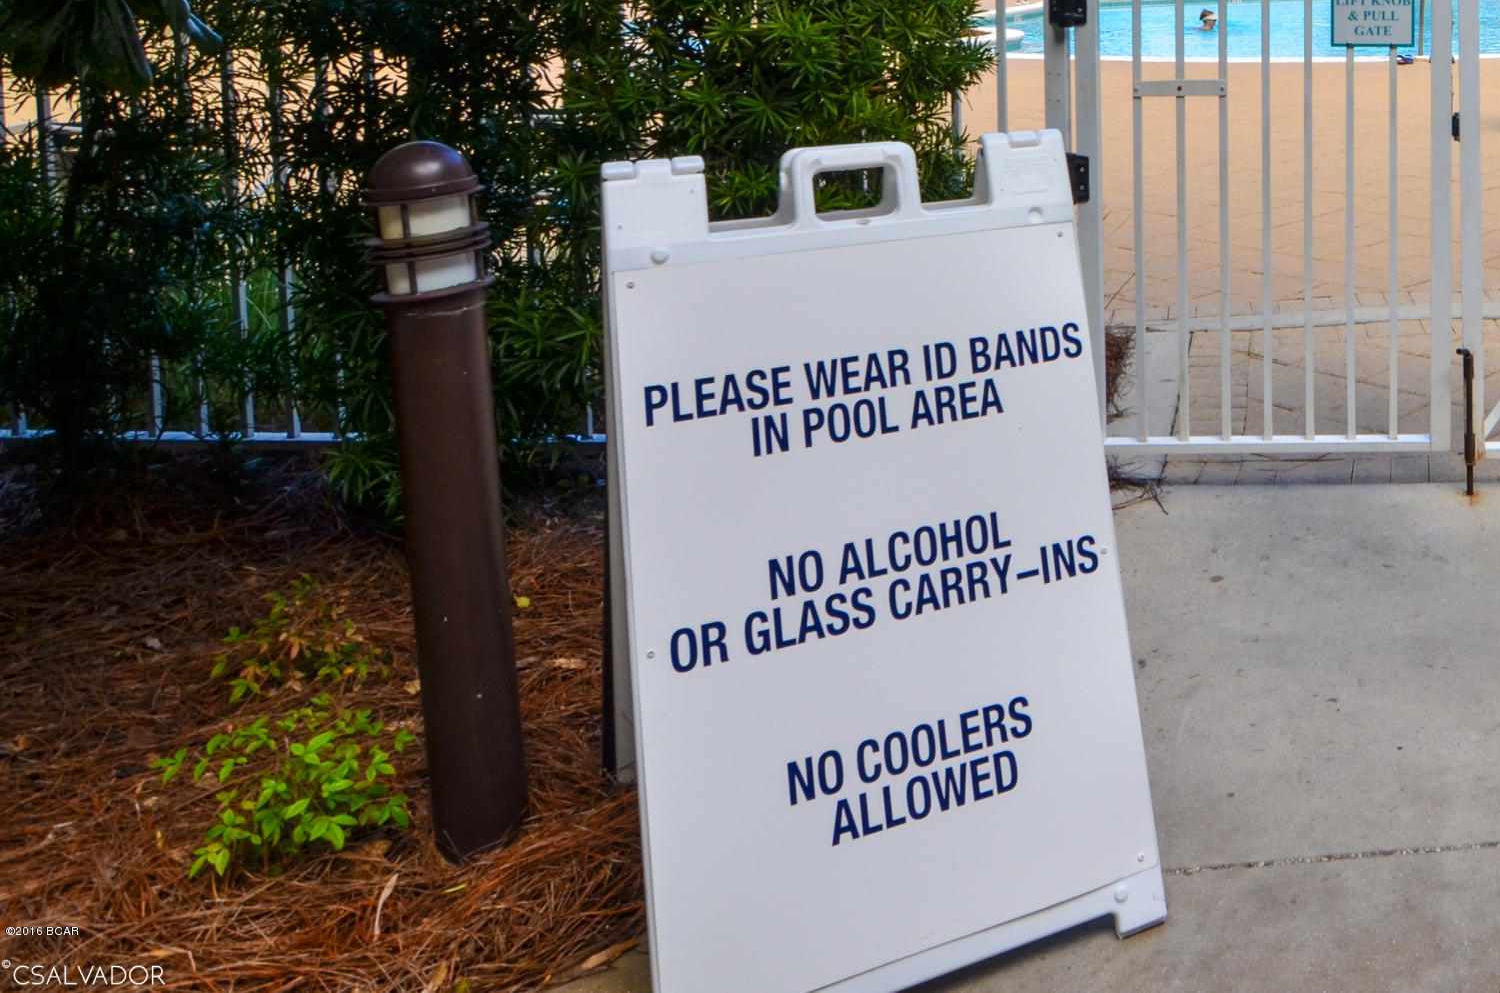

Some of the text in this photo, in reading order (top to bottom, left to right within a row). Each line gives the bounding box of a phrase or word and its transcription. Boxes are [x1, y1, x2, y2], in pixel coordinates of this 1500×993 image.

[1348, 11, 1399, 21] & PULL
[1354, 26, 1392, 36] GATE
[643, 322, 1083, 428] PLEASE WEAR ID BANDS
[751, 378, 1005, 457] IN POOL AREA
[767, 510, 1012, 601] NO ALCOHOL
[670, 621, 729, 673] OR
[744, 586, 876, 655] GLASS
[786, 696, 1033, 807] NO COOLERS
[831, 750, 1019, 847] ALLOWED
